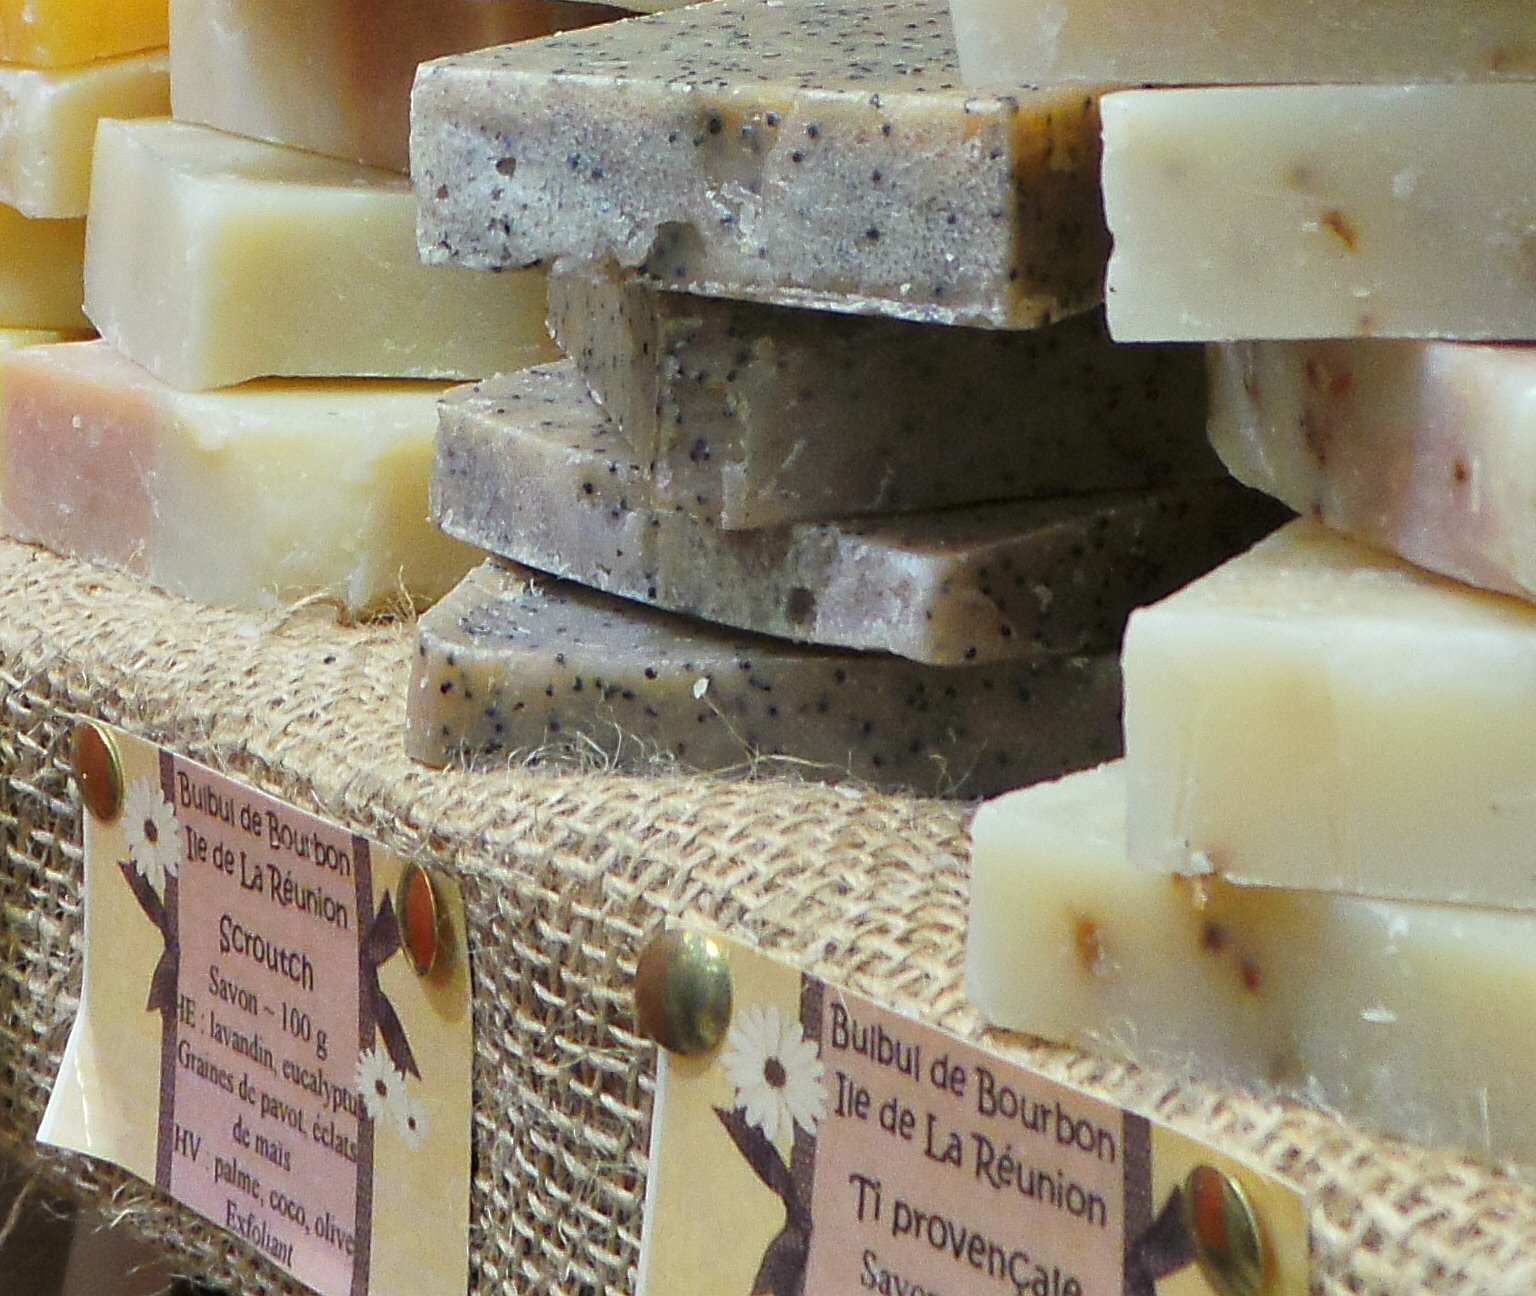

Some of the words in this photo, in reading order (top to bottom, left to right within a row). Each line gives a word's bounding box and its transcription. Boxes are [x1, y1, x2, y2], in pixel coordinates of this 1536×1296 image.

[177, 771, 235, 826] Bulbul
[240, 804, 262, 836] de
[266, 811, 351, 876] Bourbon
[185, 825, 207, 863] Ile
[213, 842, 234, 874] de
[240, 851, 263, 893] La
[266, 863, 348, 929] Réunion
[219, 913, 314, 991] Scroutch
[209, 964, 258, 1016] Savon
[282, 1002, 311, 1042] 100
[316, 1030, 327, 1061] g
[210, 1010, 277, 1077] lavandin,
[178, 1039, 234, 1094] Graines
[239, 1072, 256, 1105] de
[831, 1002, 920, 1082] Bulbul
[930, 1054, 965, 1096] de
[975, 1066, 1116, 1163] Bourbon
[233, 1113, 250, 1148] de
[835, 1071, 871, 1120] Ile
[880, 1098, 915, 1140] de
[924, 1112, 962, 1167] La
[971, 1131, 1107, 1228] Réunion
[175, 1124, 201, 1162] HV
[214, 1155, 264, 1208] palme,
[269, 1189, 310, 1235] coco,
[315, 1212, 356, 1255] olive
[849, 1173, 881, 1221] Ti
[226, 1198, 294, 1269] Exfoliant
